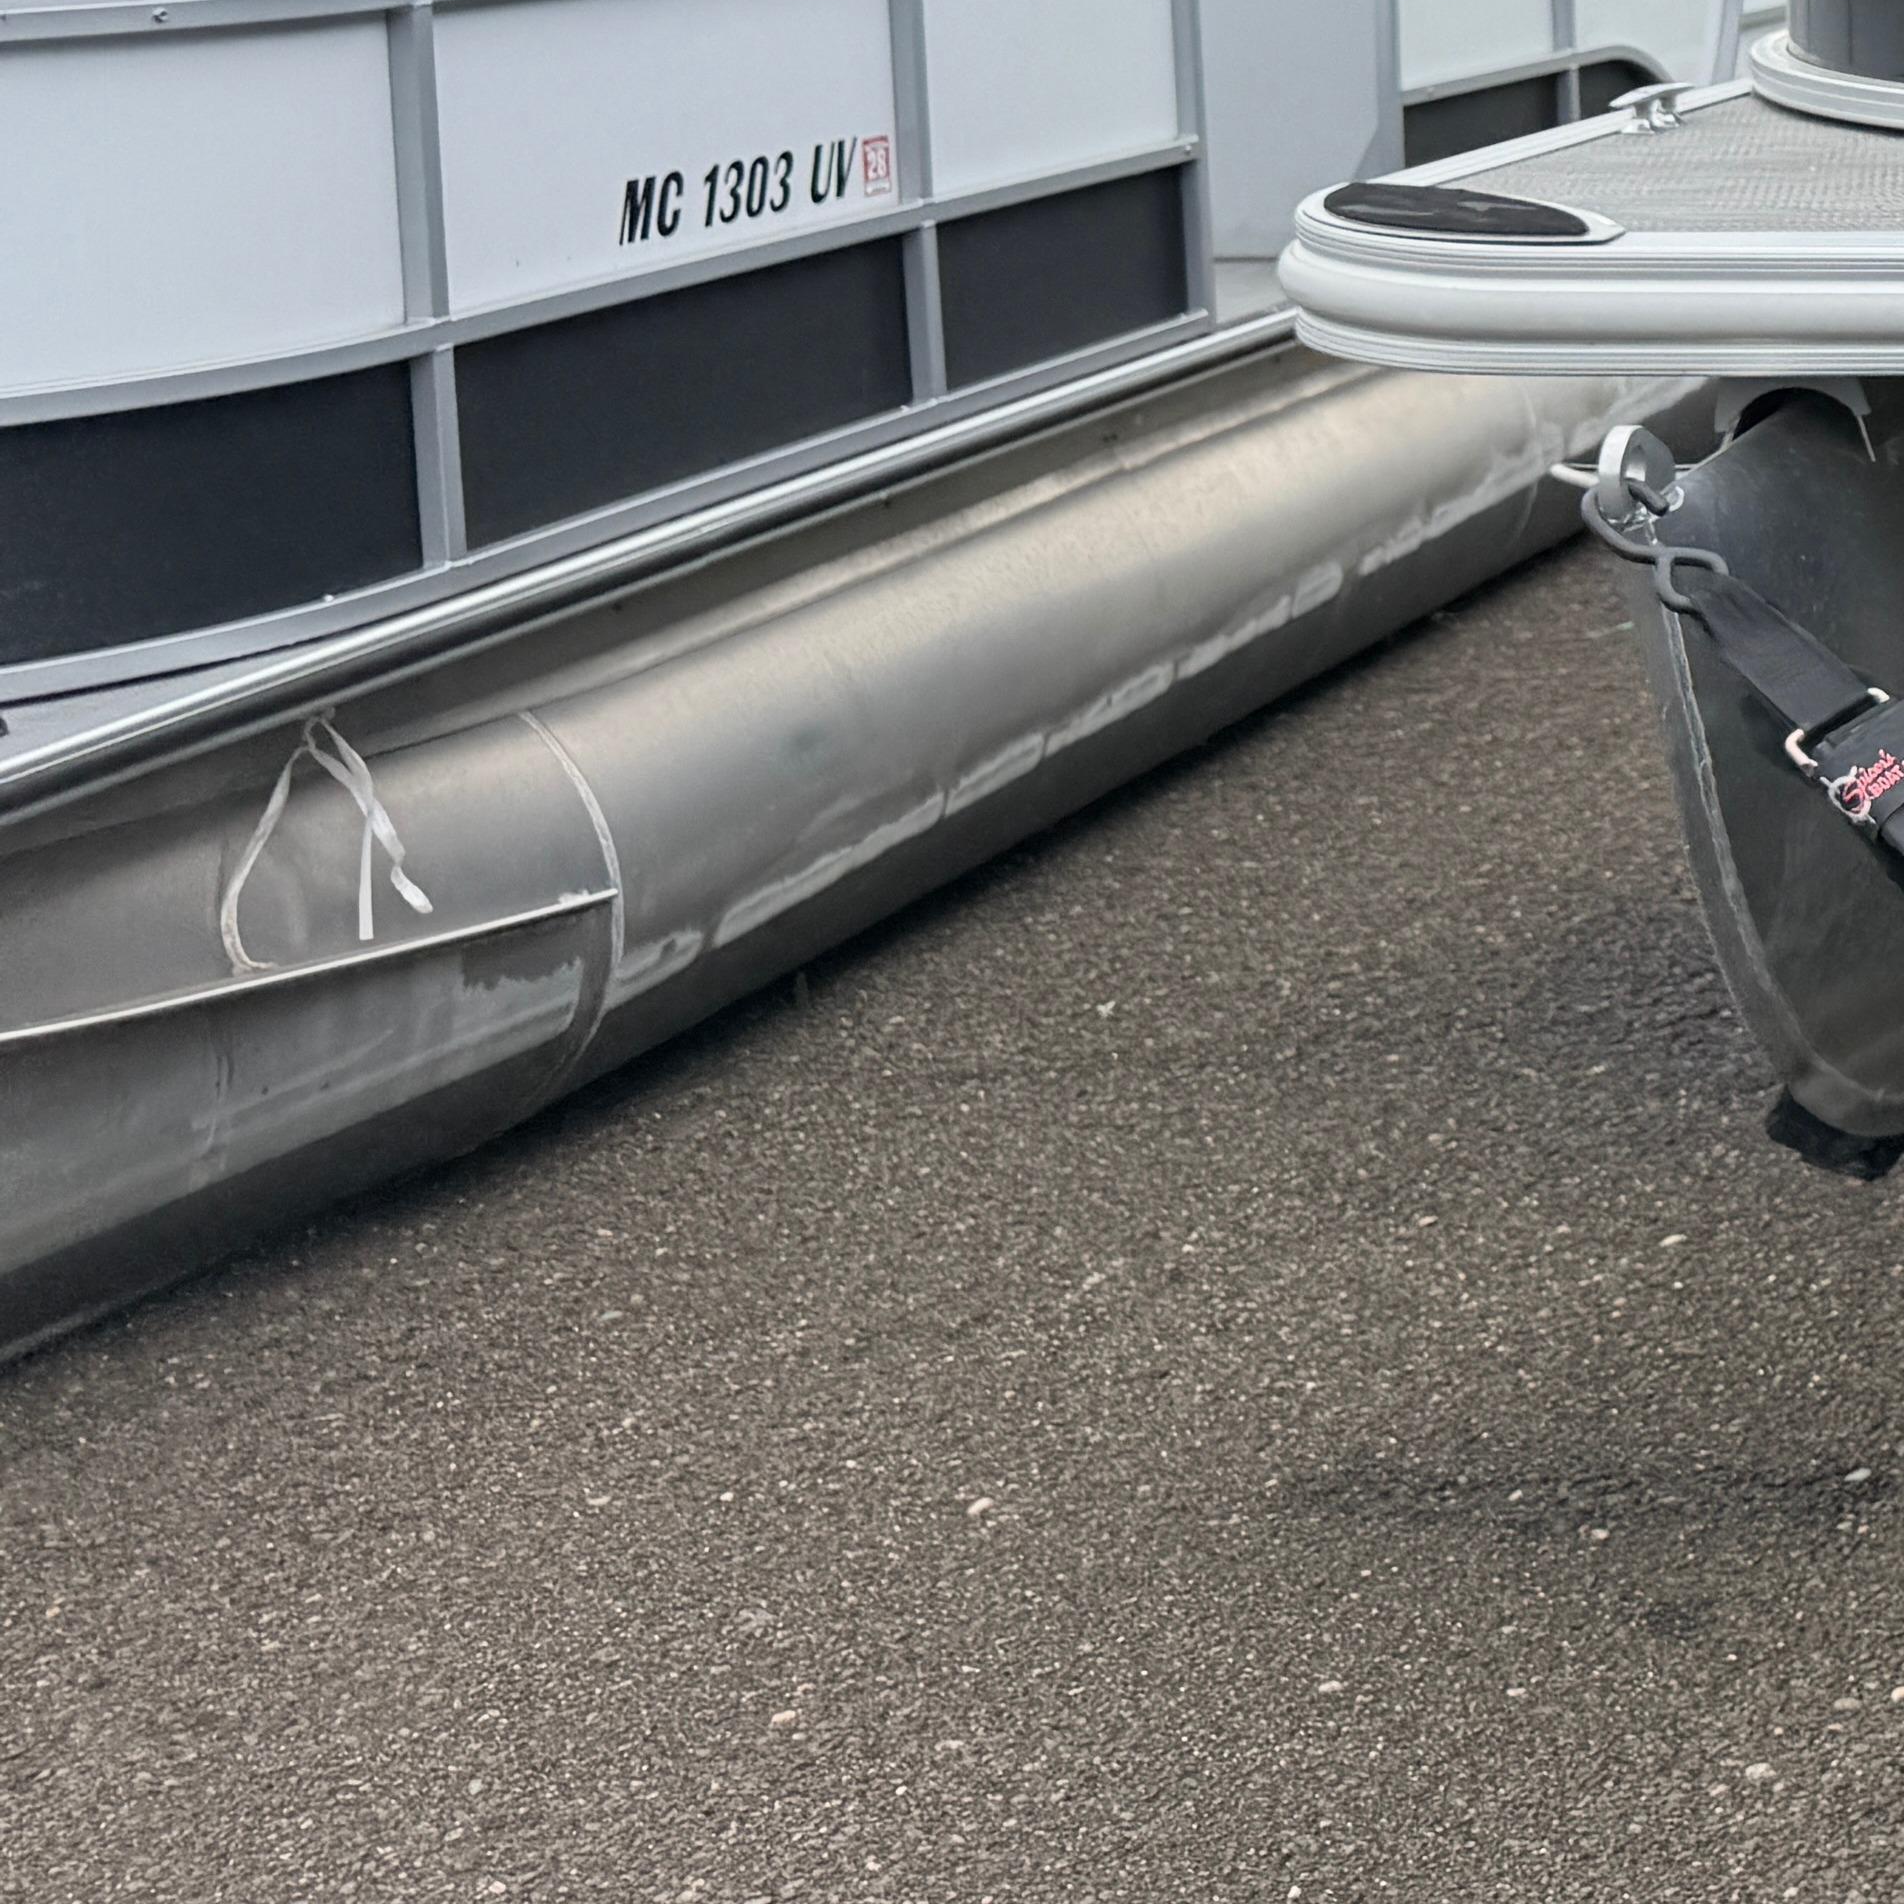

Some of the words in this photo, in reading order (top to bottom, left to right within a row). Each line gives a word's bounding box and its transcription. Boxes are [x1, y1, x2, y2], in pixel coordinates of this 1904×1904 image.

[619, 171, 684, 246] MC
[704, 150, 794, 227] 1303
[811, 137, 857, 203] UV
[1867, 765, 1904, 797] BOAT
